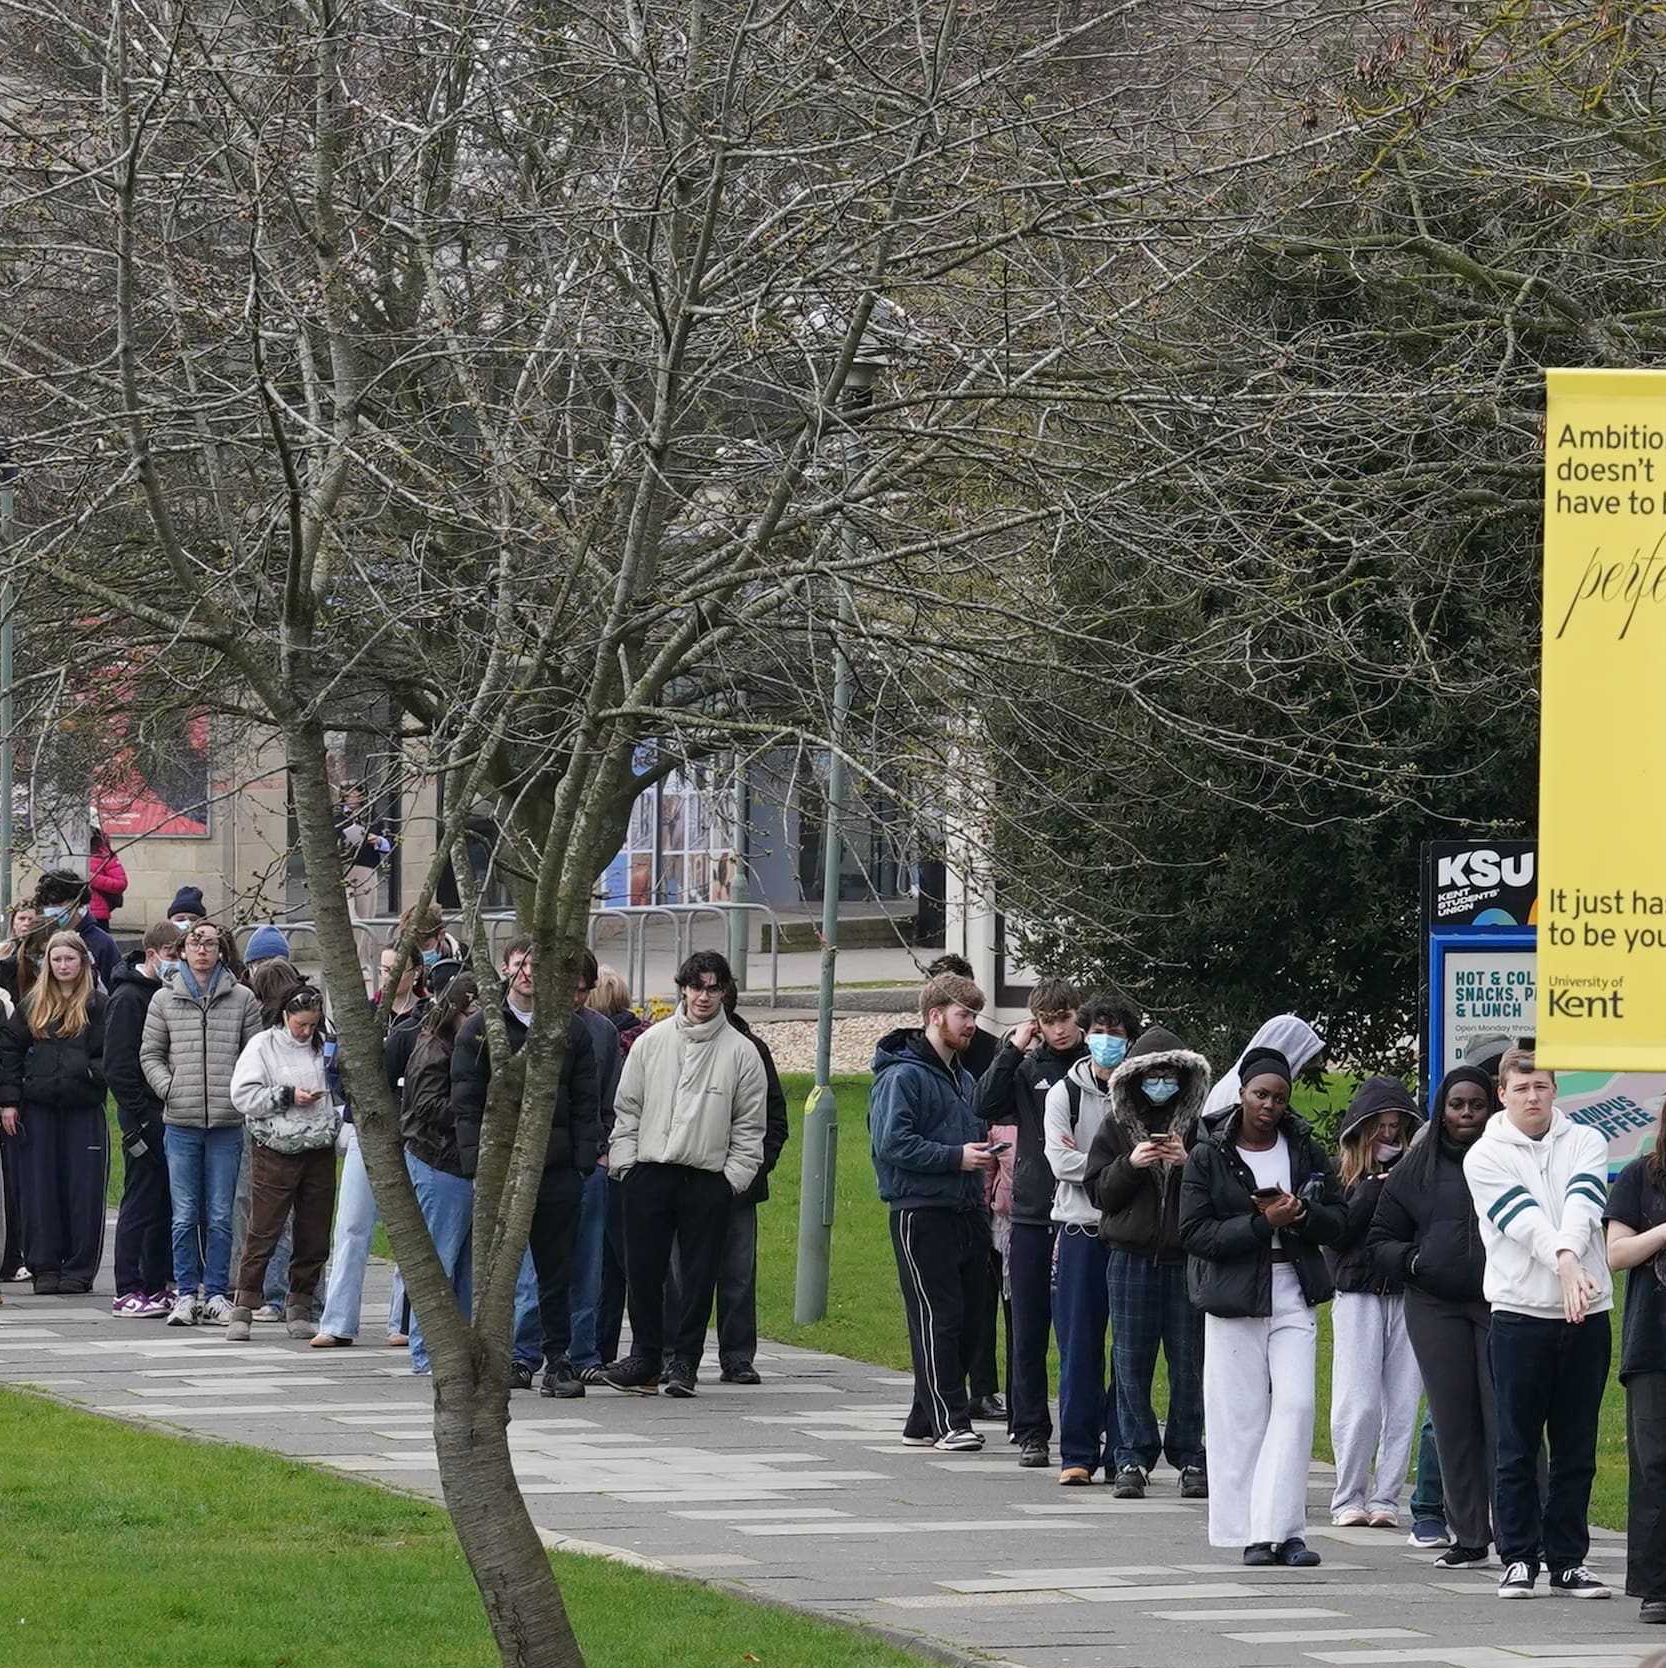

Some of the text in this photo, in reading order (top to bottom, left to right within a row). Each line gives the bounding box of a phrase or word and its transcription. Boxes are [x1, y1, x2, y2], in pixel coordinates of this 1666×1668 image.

[1557, 456, 1654, 482] doesn't
[1556, 489, 1620, 514] have
[1628, 490, 1655, 515] to
[1438, 849, 1534, 887] KSU
[1437, 887, 1471, 902] KENT
[1550, 888, 1566, 913] It
[1572, 889, 1624, 920] just
[1437, 902, 1474, 917] UNION
[1549, 921, 1575, 946] to
[1584, 922, 1616, 946] be
[1456, 971, 1536, 986] HOT & COL
[1549, 975, 1624, 991] University of
[1456, 1003, 1522, 1018] & LUNCH
[1549, 989, 1624, 1018] Kent
[1455, 1024, 1477, 1033] Open
[1478, 1024, 1511, 1033] Monday
[1565, 1095, 1637, 1126] AMPUS
[1591, 1107, 1658, 1143] FFEE
